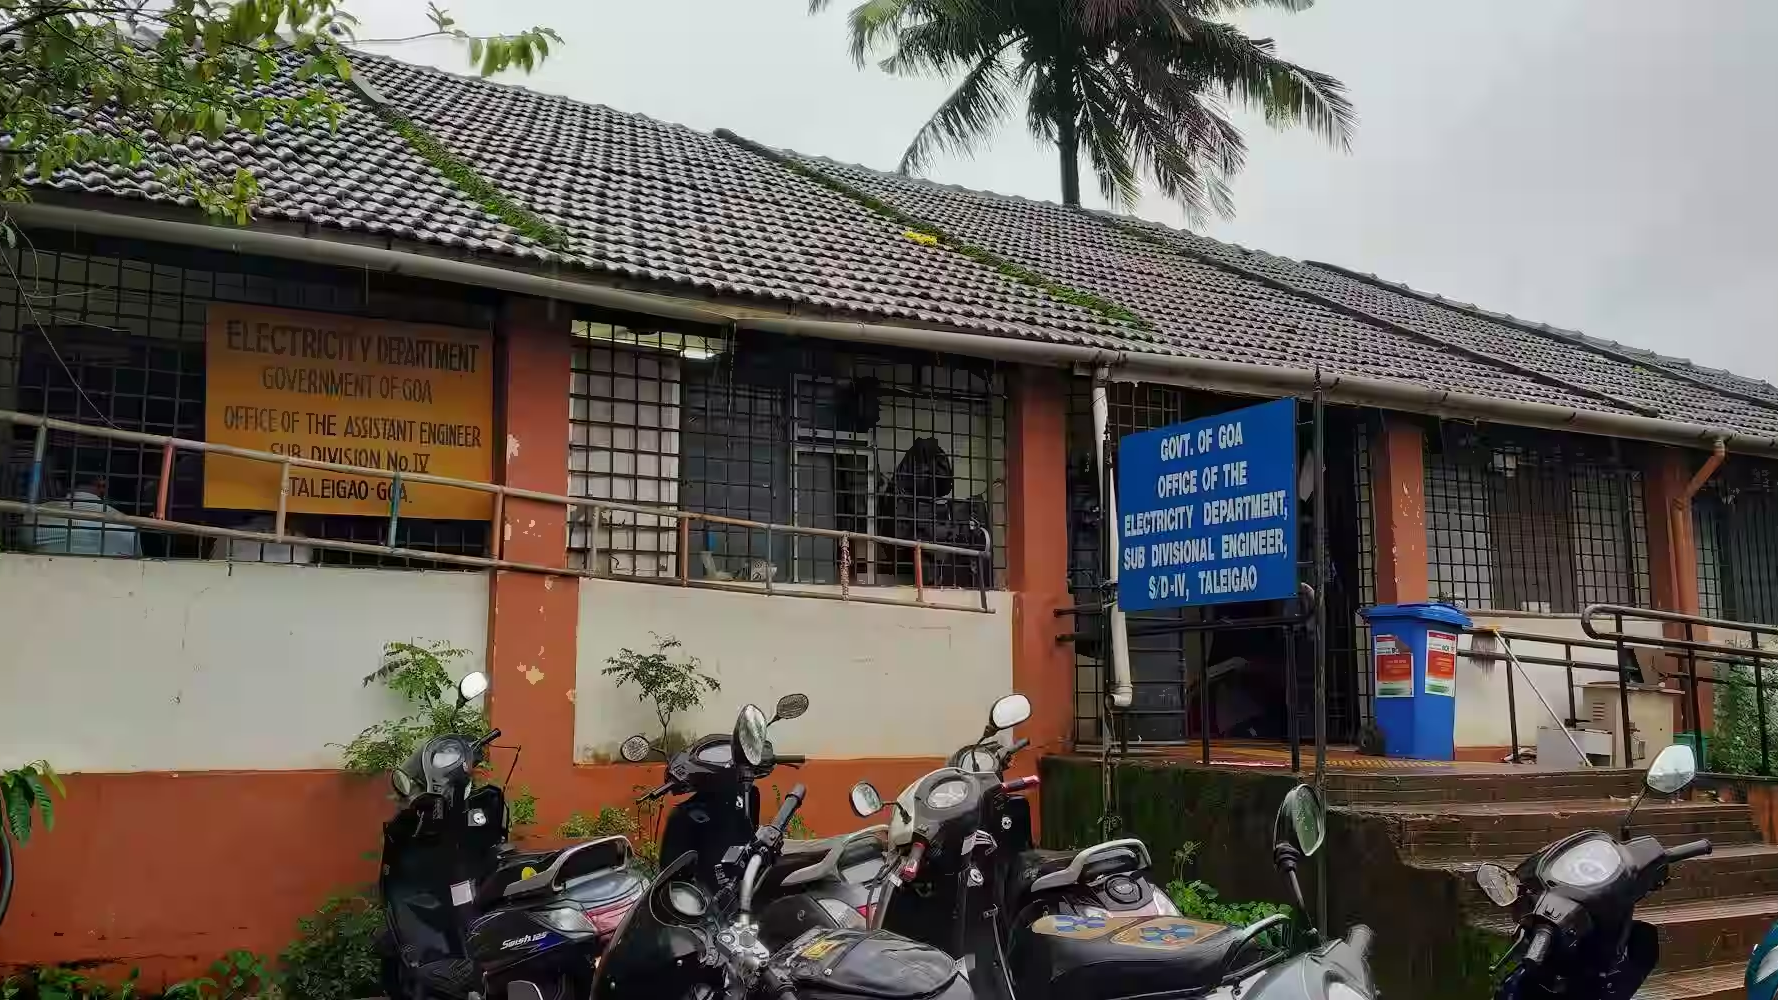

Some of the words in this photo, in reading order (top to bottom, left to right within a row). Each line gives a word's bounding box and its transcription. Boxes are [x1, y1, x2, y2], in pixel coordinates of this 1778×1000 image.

[226, 320, 375, 363] ELECTRICITY
[377, 335, 479, 373] DEPARTMENT
[262, 366, 375, 399] GOVERNMENT
[379, 375, 399, 400] OF
[402, 379, 432, 404] GOA
[224, 405, 277, 434] OFFICE
[281, 411, 300, 434] OF
[306, 413, 337, 436] THE
[343, 415, 416, 443] ASSISTANT
[419, 422, 481, 448] ENGINEER
[1160, 433, 1194, 461] GOVT.
[1197, 428, 1213, 454] OF
[1218, 422, 1243, 450] GOA
[311, 445, 381, 468] DIVISION
[1157, 470, 1198, 498] OFFICE
[1202, 466, 1218, 491] OF
[1222, 461, 1248, 488] THE
[1124, 505, 1194, 537] ELECTRICITY
[1203, 490, 1288, 526] DEPARTMENT,
[1123, 546, 1145, 571] SUB
[1151, 537, 1215, 567] DIVISIONAL
[1221, 528, 1288, 560] ENGINEER,
[1198, 565, 1258, 595] TALEIGAO
